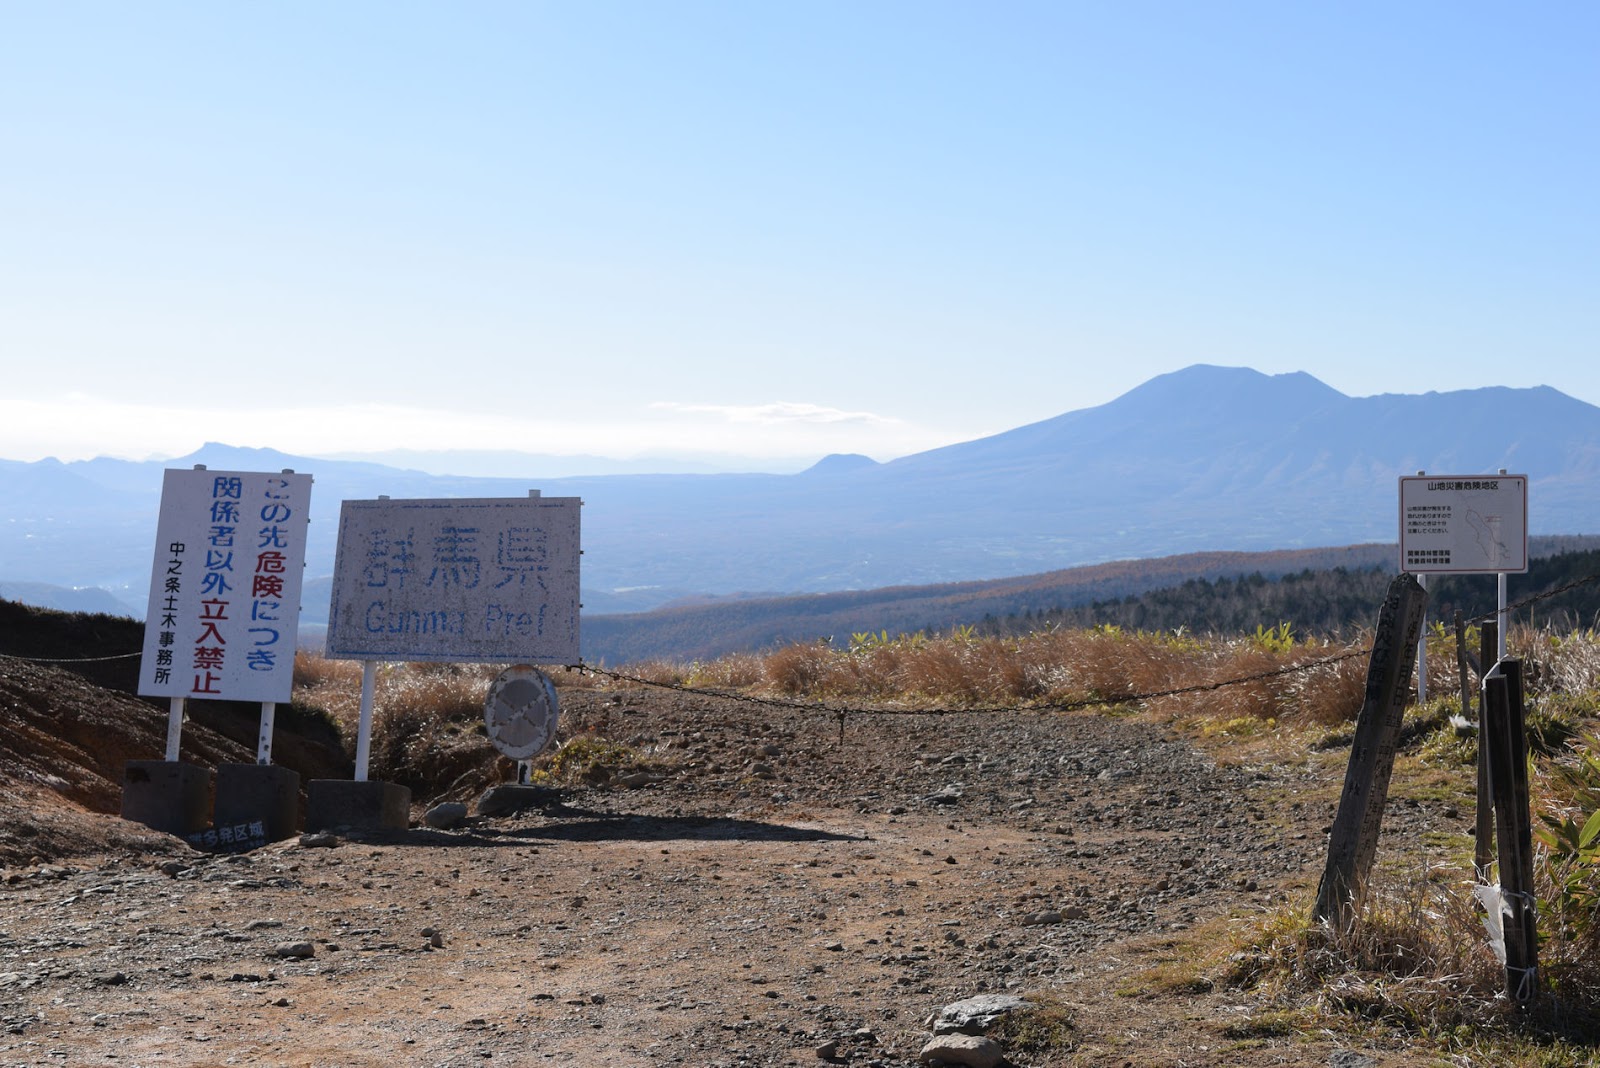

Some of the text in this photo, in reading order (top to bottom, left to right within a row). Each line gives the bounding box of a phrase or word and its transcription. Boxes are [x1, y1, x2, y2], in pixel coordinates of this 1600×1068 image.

[1428, 481, 1498, 491] 山地災害危険地区
[154, 541, 185, 684] 中之条土木事務所
[192, 476, 243, 694] 関係者以外立入禁止
[246, 478, 291, 671] この先危険につき
[363, 526, 550, 595] 群馬県
[365, 601, 548, 636] Gunma Pref
